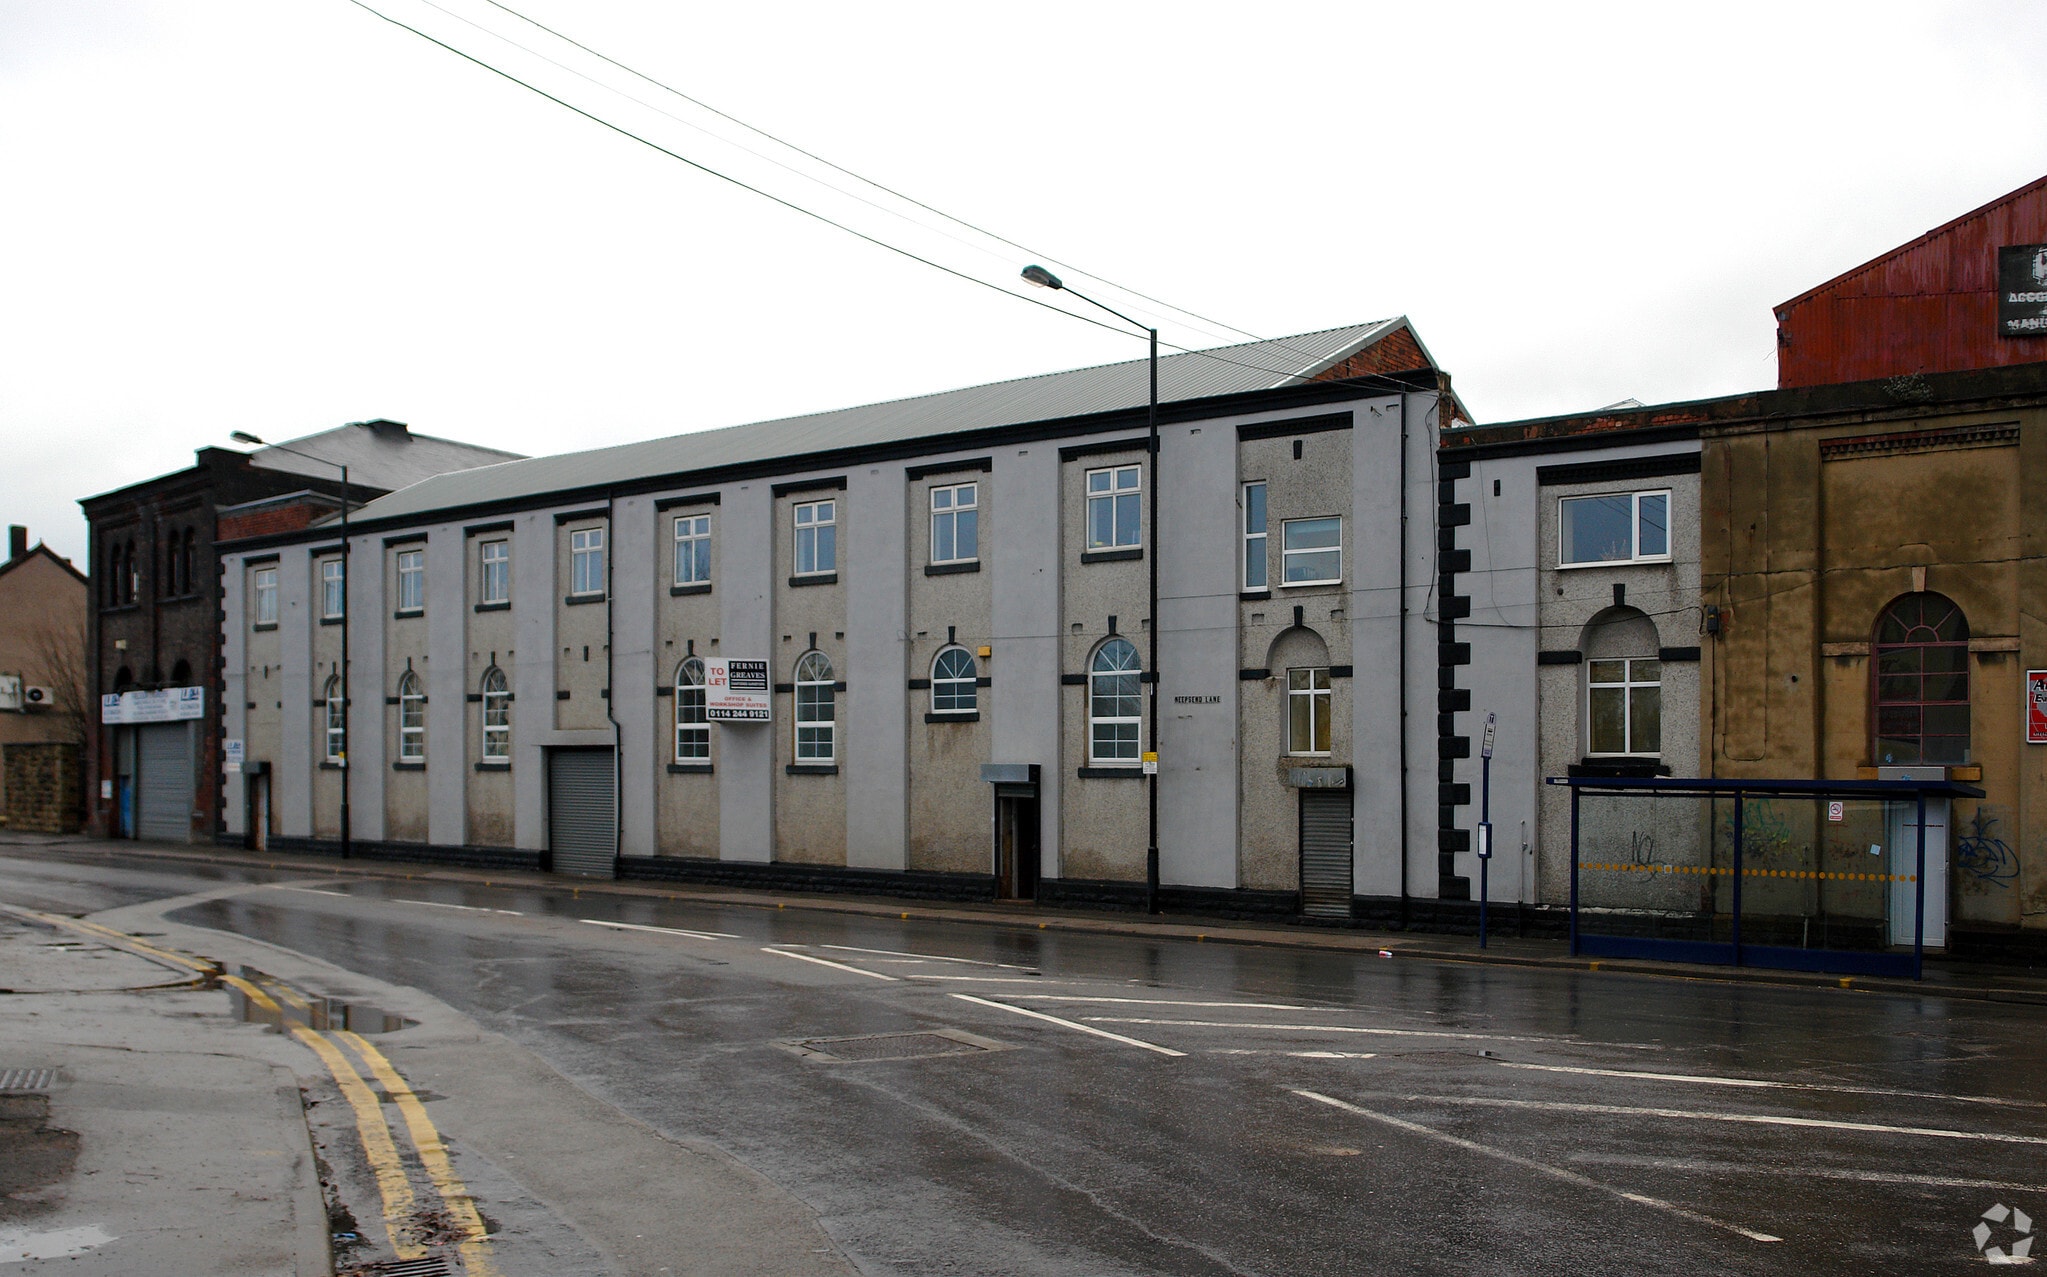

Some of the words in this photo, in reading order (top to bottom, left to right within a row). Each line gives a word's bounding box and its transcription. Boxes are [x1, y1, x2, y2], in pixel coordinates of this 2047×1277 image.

[731, 662, 764, 670] FERNIE
[710, 667, 724, 676] TO
[709, 678, 727, 686] LET
[710, 709, 731, 717] 0114
[732, 710, 748, 718] 244
